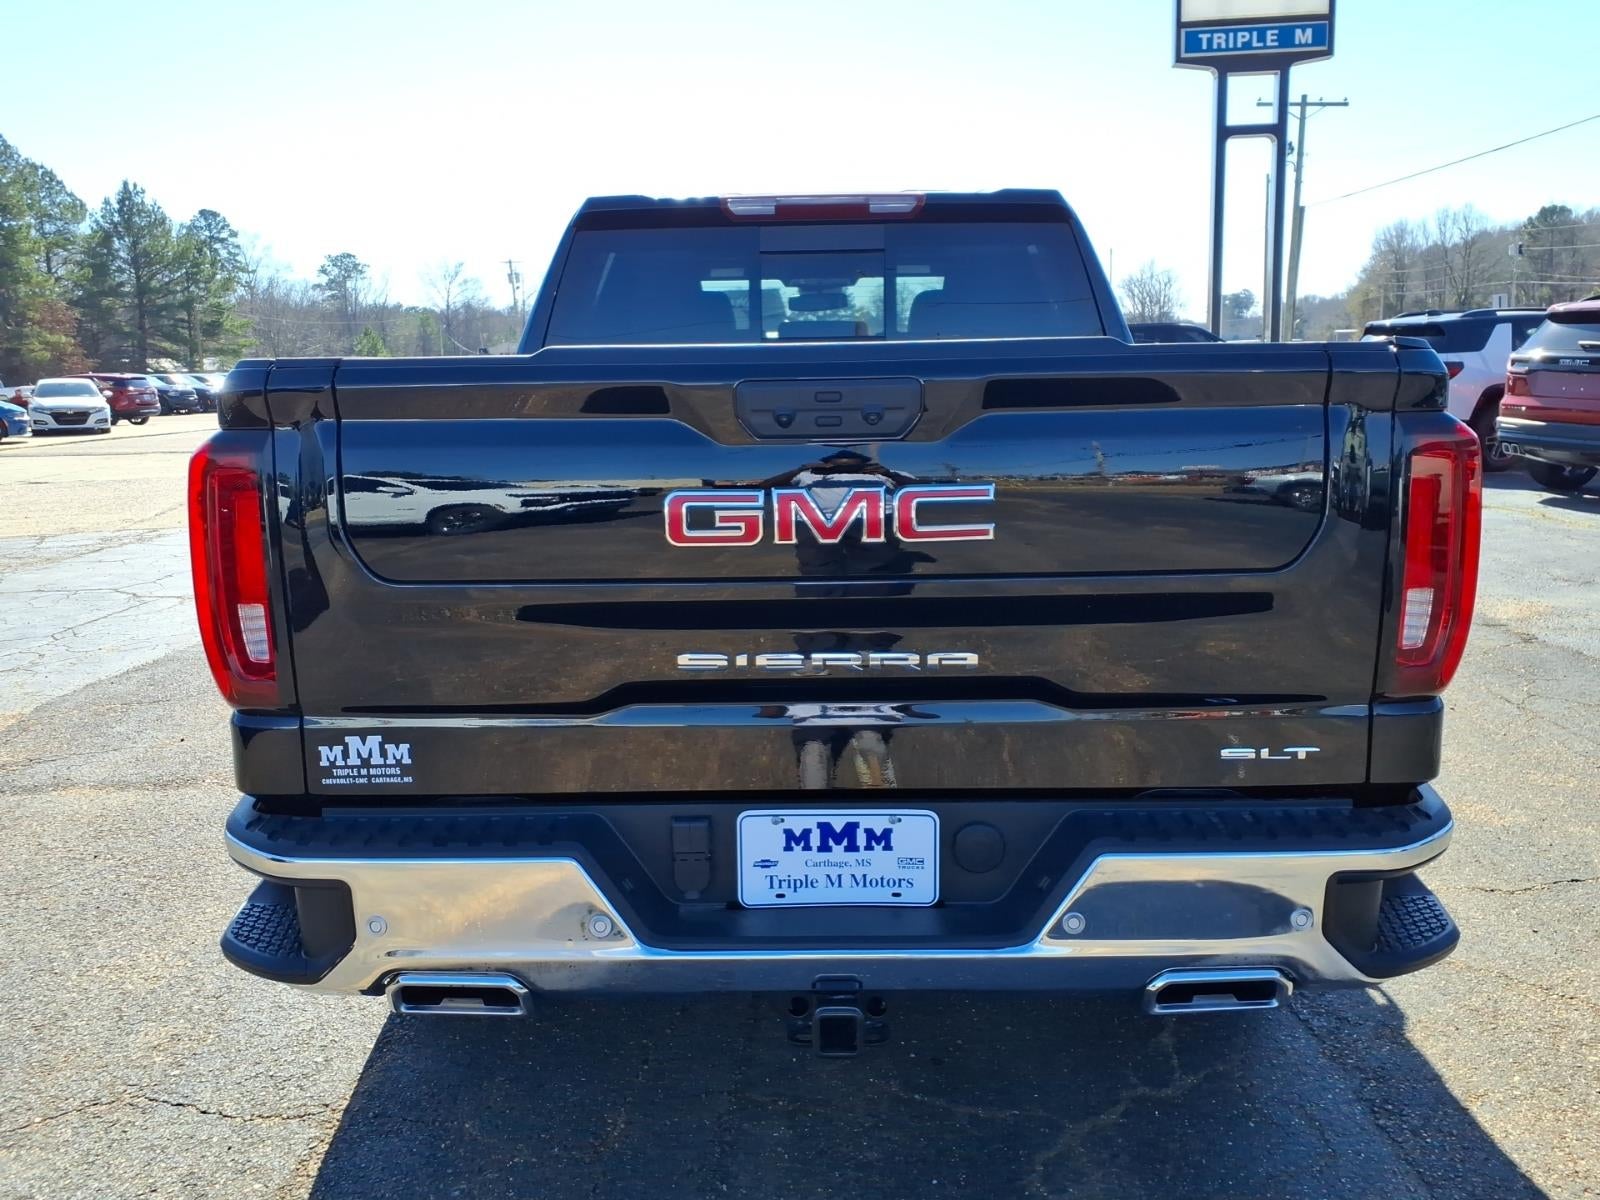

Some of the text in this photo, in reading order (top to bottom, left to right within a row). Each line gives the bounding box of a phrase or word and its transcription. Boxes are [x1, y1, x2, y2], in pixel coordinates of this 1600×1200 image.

[1198, 28, 1313, 50] TRIPLE M
[664, 483, 996, 547] GMC
[676, 652, 980, 672] SIERRA
[1220, 747, 1321, 760] SLT
[332, 767, 401, 777] TRIPLE M MOTORS
[804, 858, 873, 869] Carthage, MS
[897, 857, 925, 866] GMC
[765, 873, 915, 893] Triple M Motors
